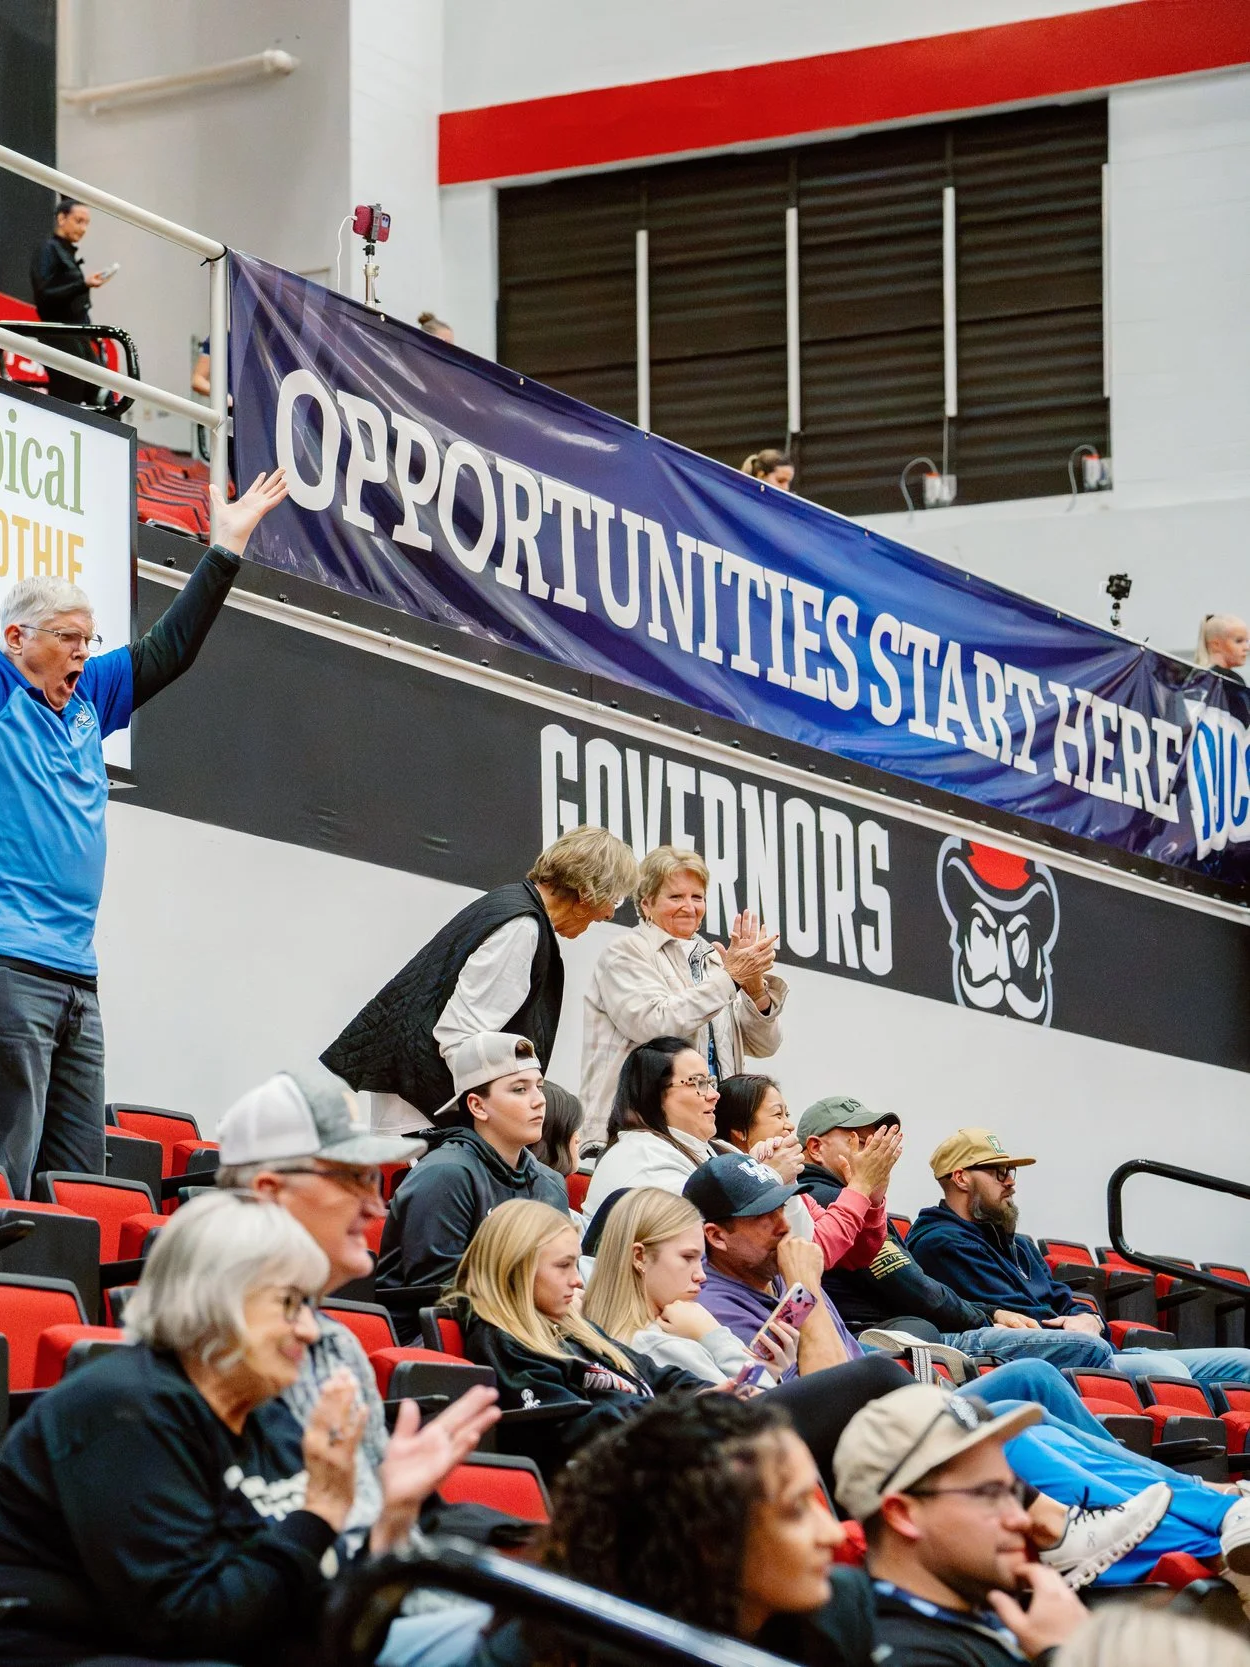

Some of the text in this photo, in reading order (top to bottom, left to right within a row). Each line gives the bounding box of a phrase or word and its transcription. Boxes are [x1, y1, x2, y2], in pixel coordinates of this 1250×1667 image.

[275, 369, 1182, 824] OPPORTUNITIES START HERE
